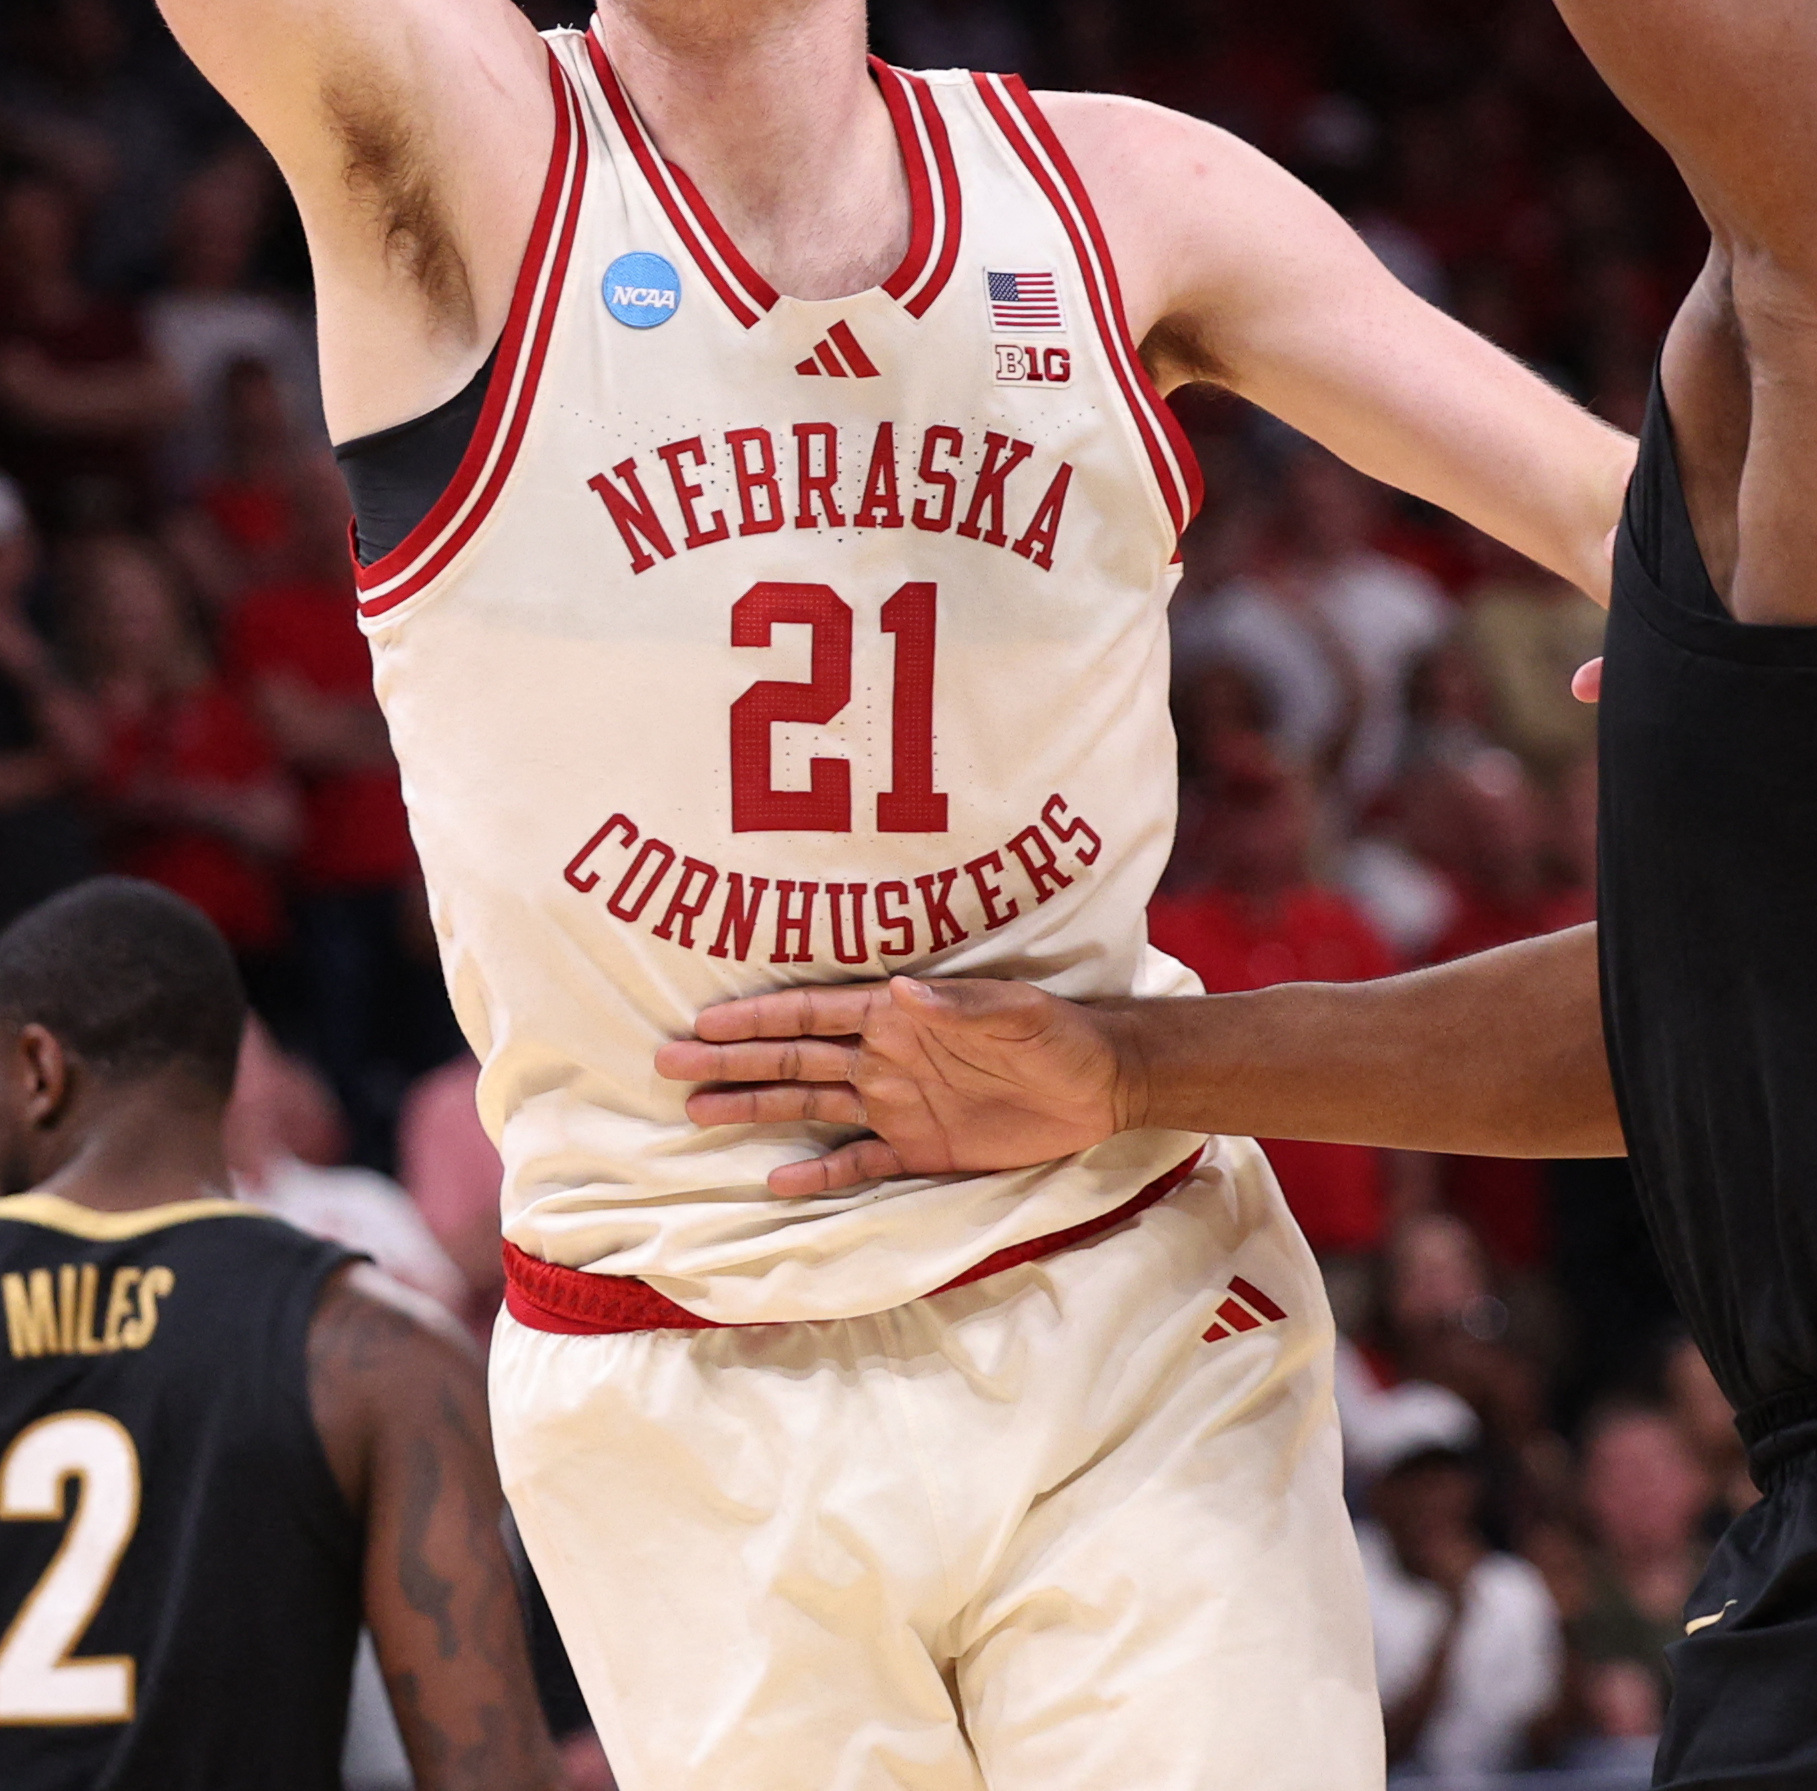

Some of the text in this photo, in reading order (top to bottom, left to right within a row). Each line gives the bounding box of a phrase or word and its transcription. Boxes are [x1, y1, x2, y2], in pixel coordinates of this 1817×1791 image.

[611, 285, 677, 309] NCAA
[586, 421, 1074, 575] NEBRASKA
[729, 580, 949, 834] 21
[563, 793, 1102, 964] CORNHUSKERS
[0, 1262, 177, 1360] MILES
